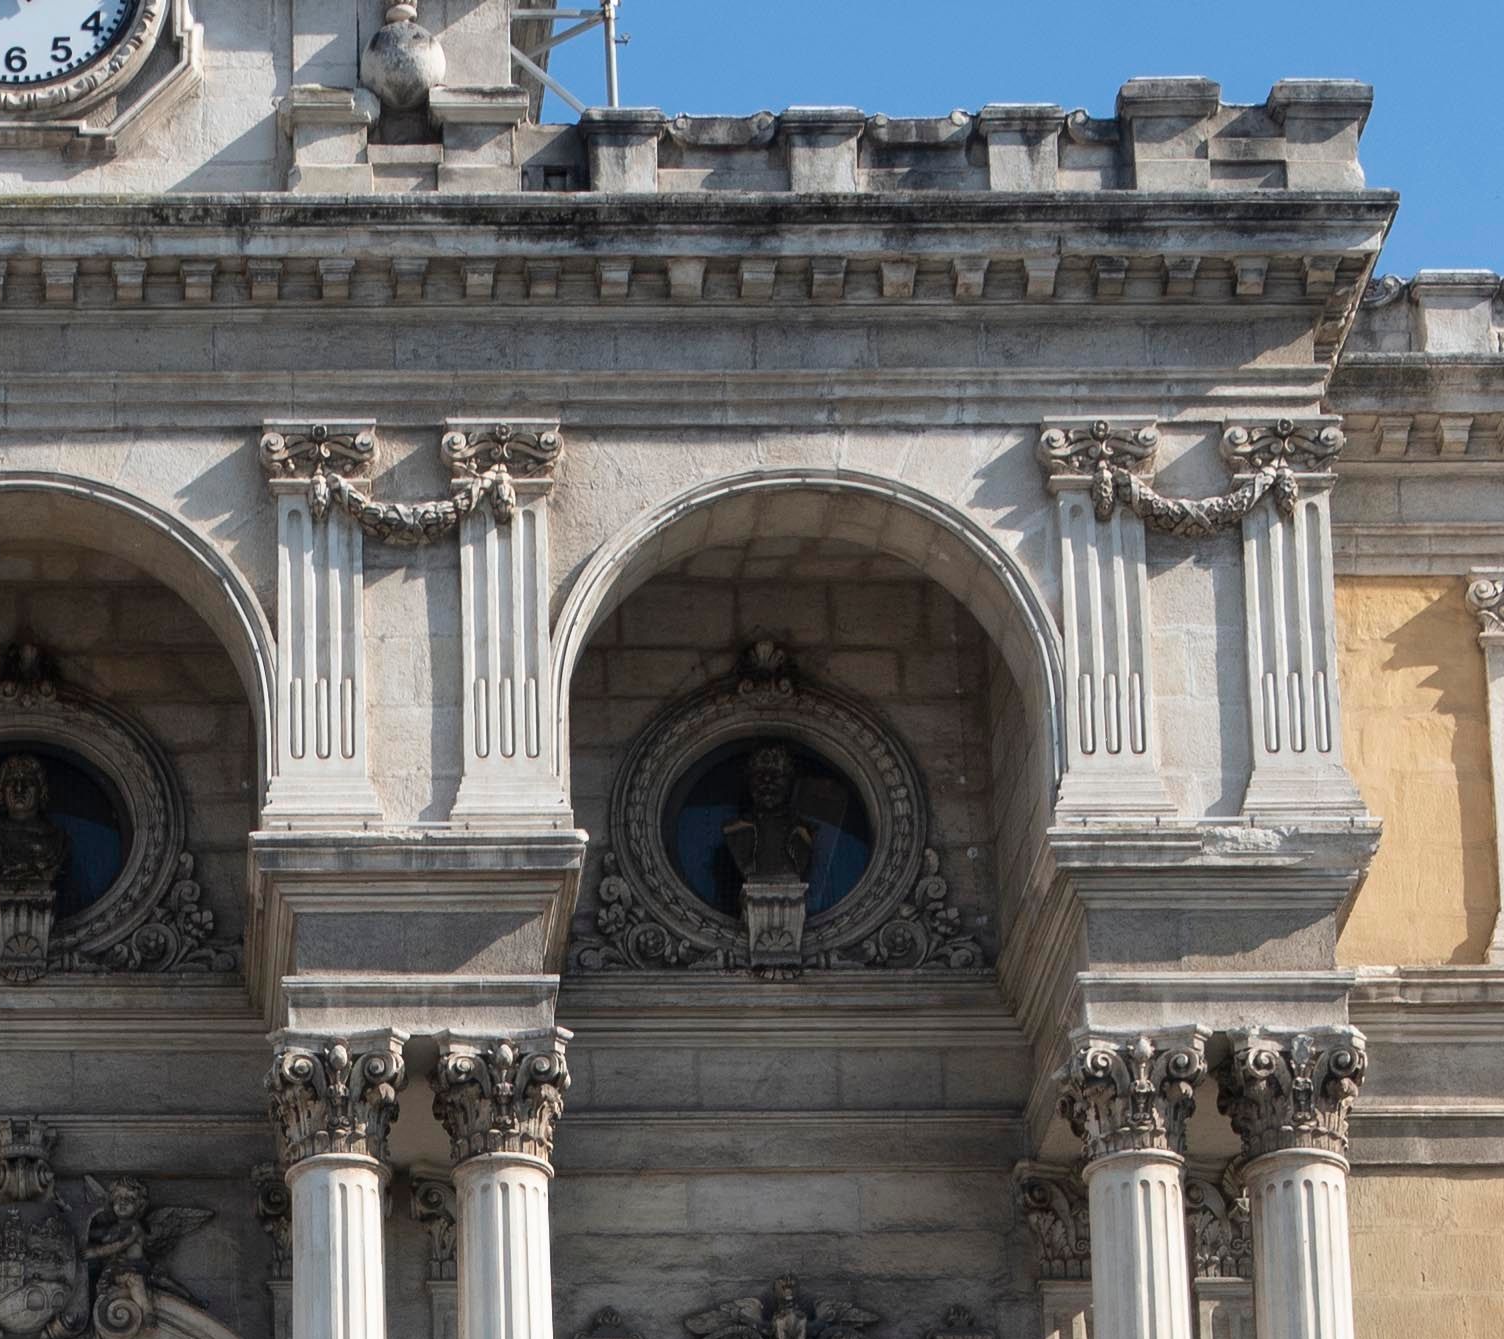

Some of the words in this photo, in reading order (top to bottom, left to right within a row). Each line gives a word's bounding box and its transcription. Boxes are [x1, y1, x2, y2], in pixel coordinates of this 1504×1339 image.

[81, 10, 104, 37] 4
[4, 46, 28, 73] 6
[50, 36, 73, 63] 5
